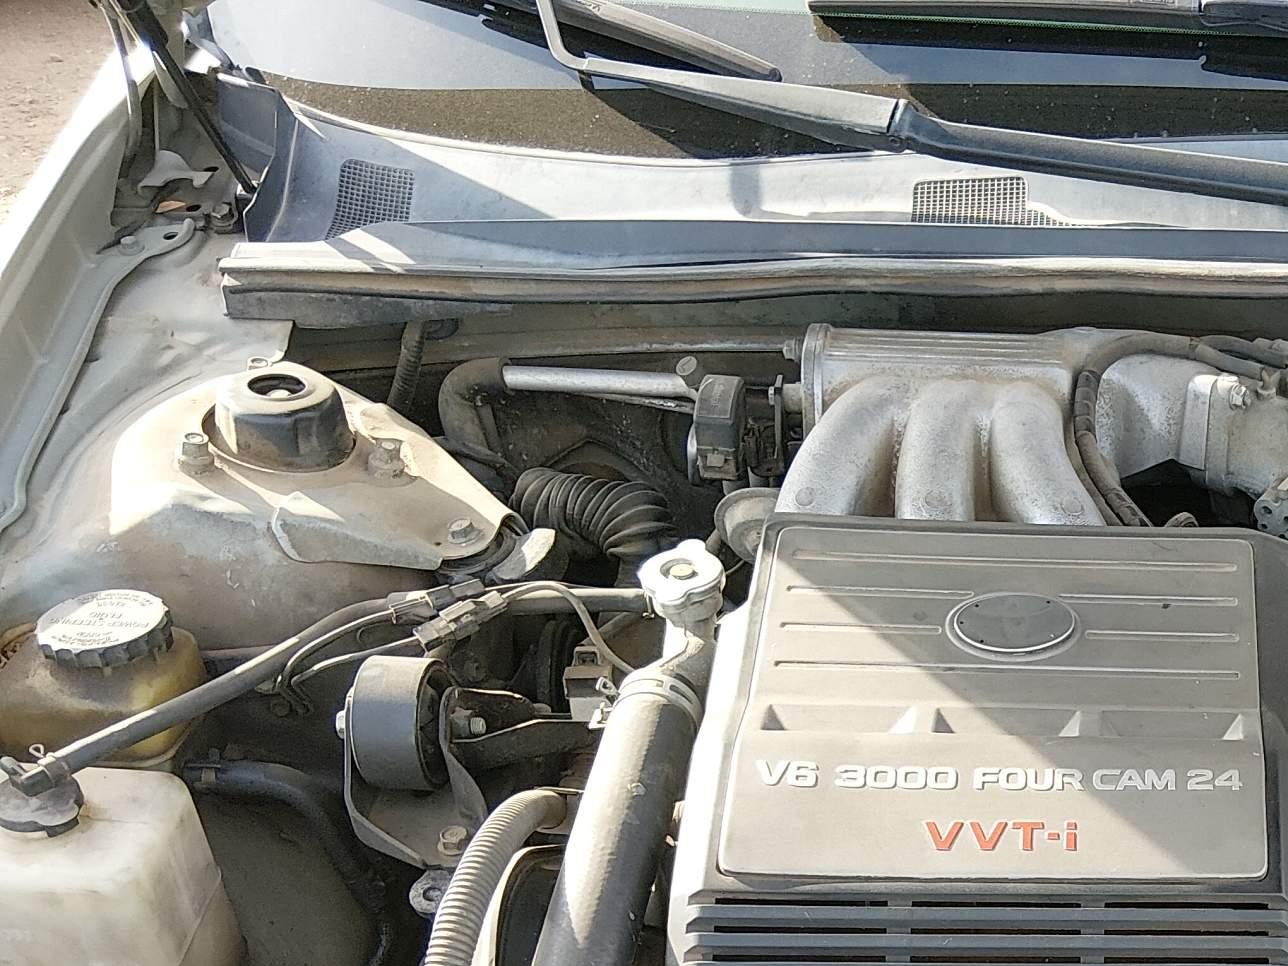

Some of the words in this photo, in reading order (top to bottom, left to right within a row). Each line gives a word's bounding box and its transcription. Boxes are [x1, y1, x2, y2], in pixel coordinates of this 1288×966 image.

[755, 760, 819, 789] V6
[834, 765, 959, 790] 3000
[972, 766, 1084, 791] FOUR
[1092, 768, 1176, 791] CAM
[1186, 769, 1243, 790] 24
[923, 819, 1078, 851] VVT-i
